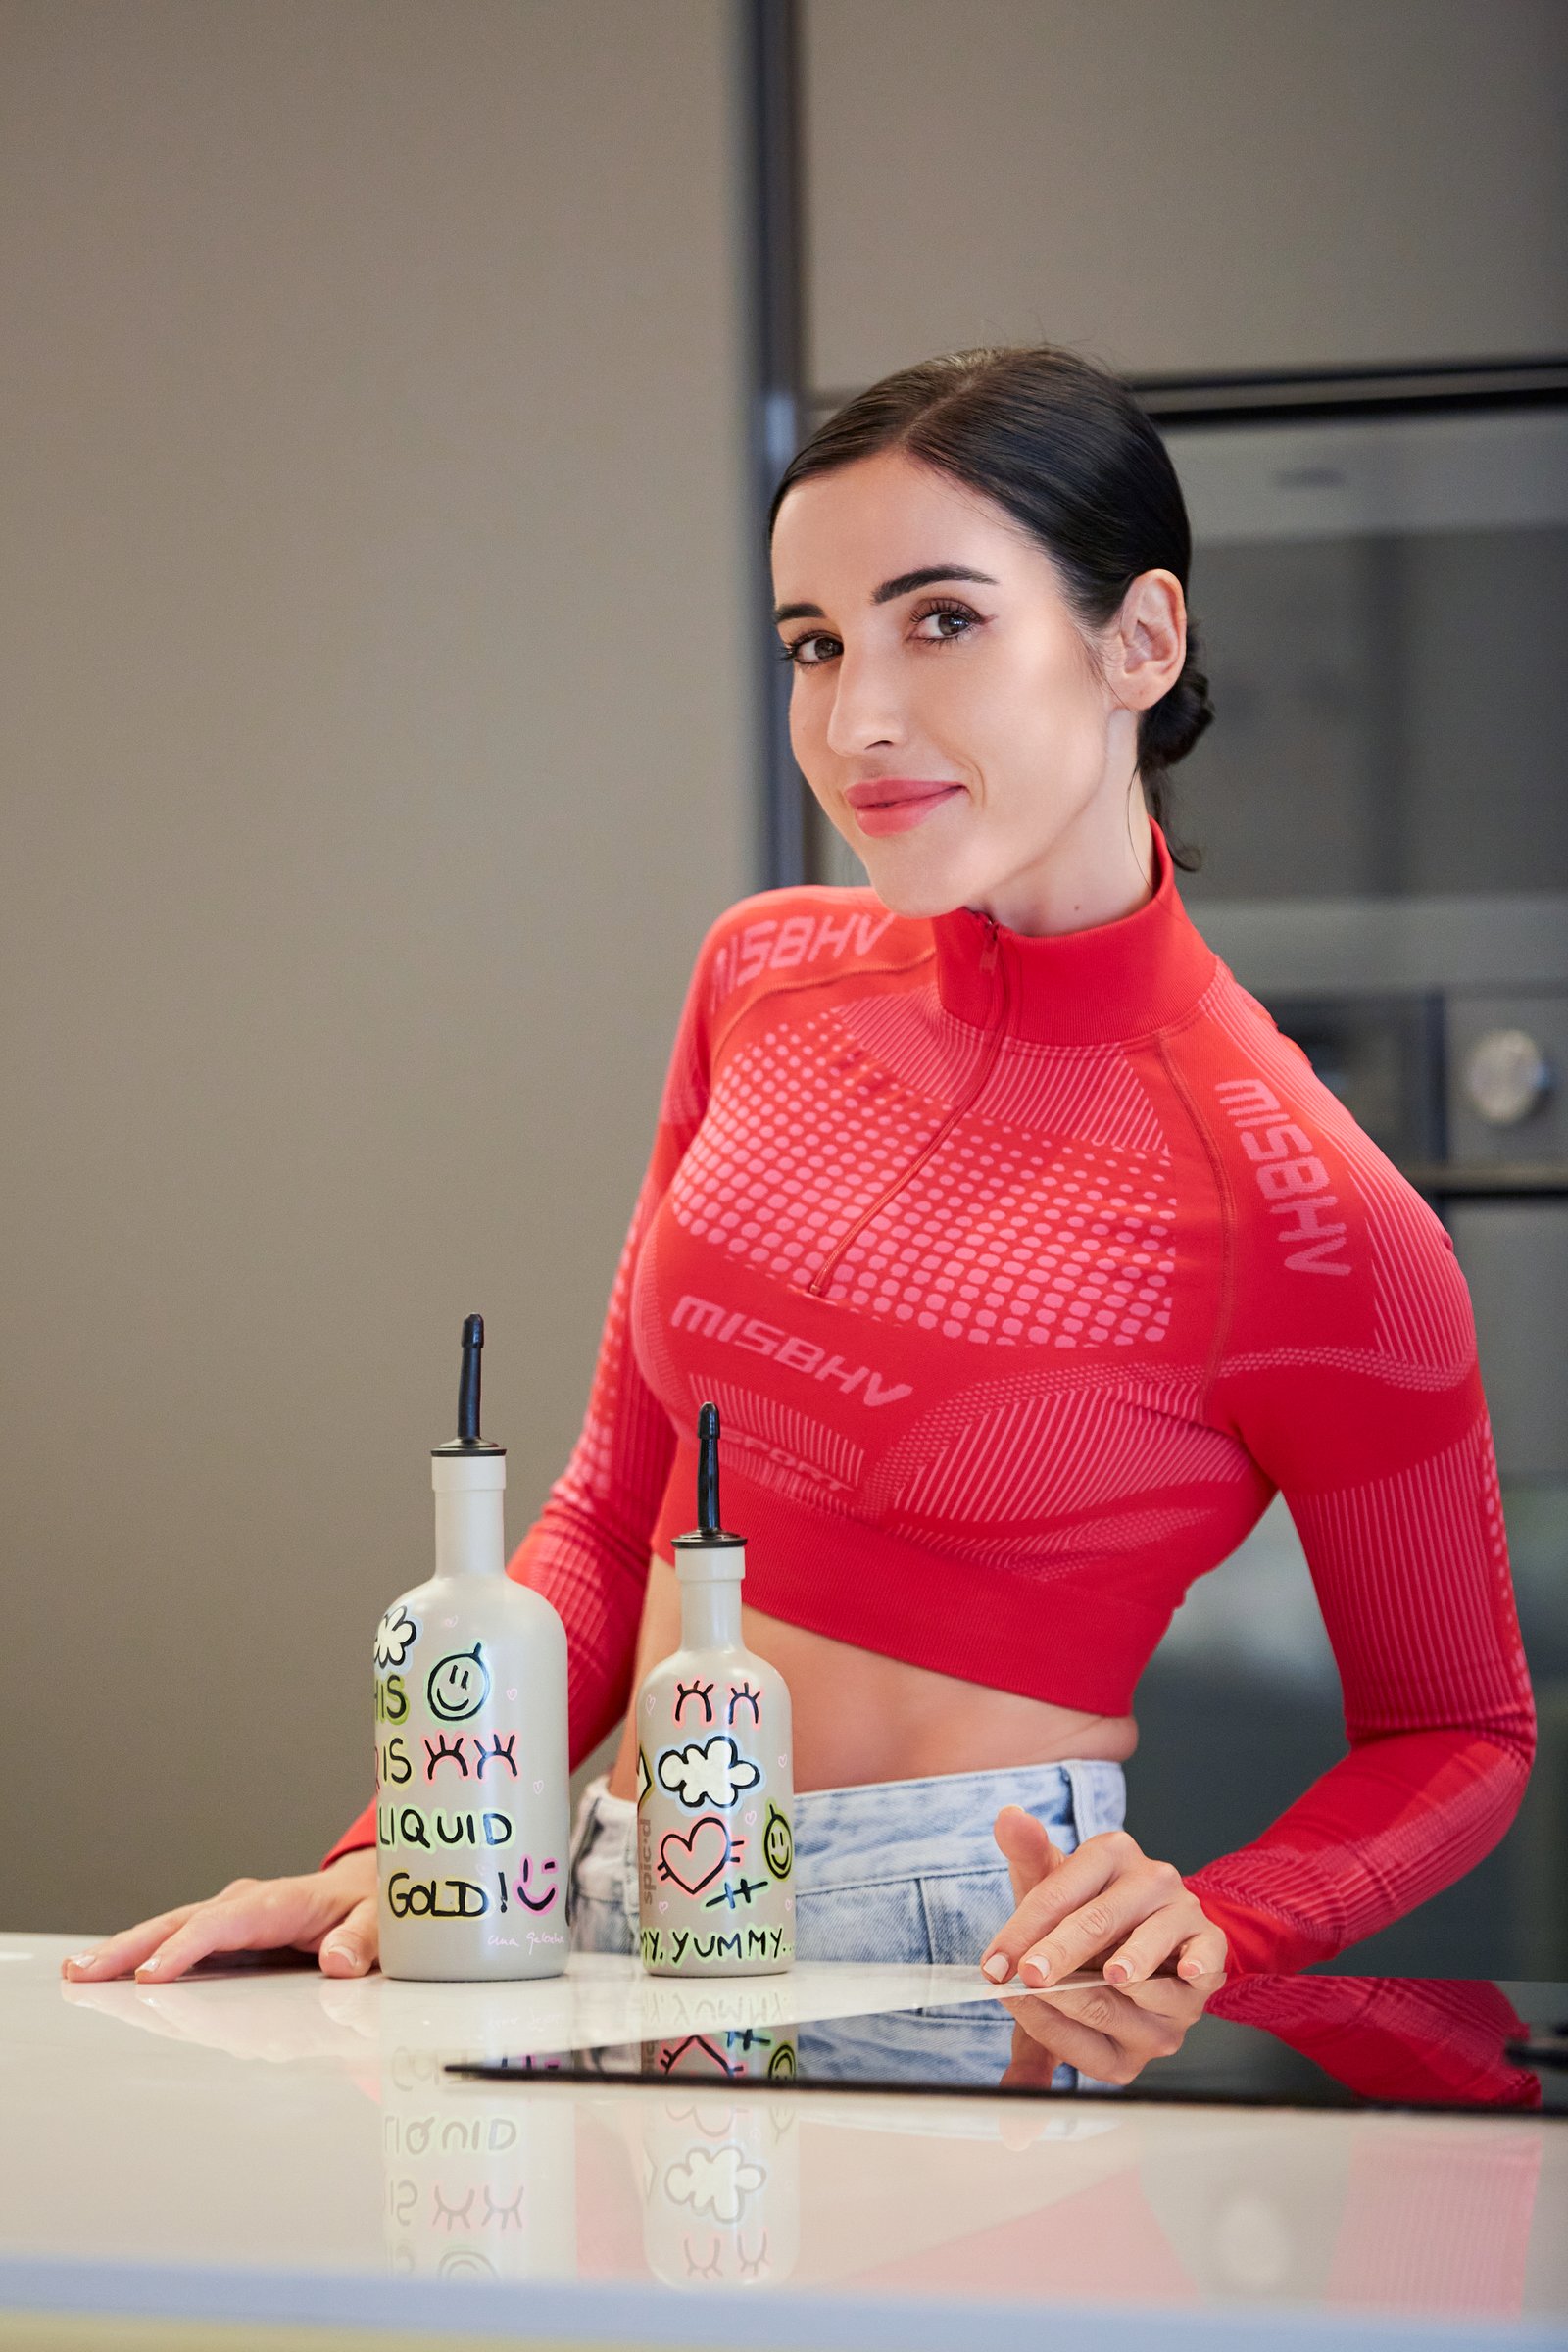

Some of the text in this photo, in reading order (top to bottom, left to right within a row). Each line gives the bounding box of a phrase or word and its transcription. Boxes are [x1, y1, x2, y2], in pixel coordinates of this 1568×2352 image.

[1214, 1078, 1353, 1278] MISBHV
[670, 1294, 915, 1408] MISBHV
[383, 1737, 413, 1785] IS
[379, 1808, 513, 1850] LIQUID
